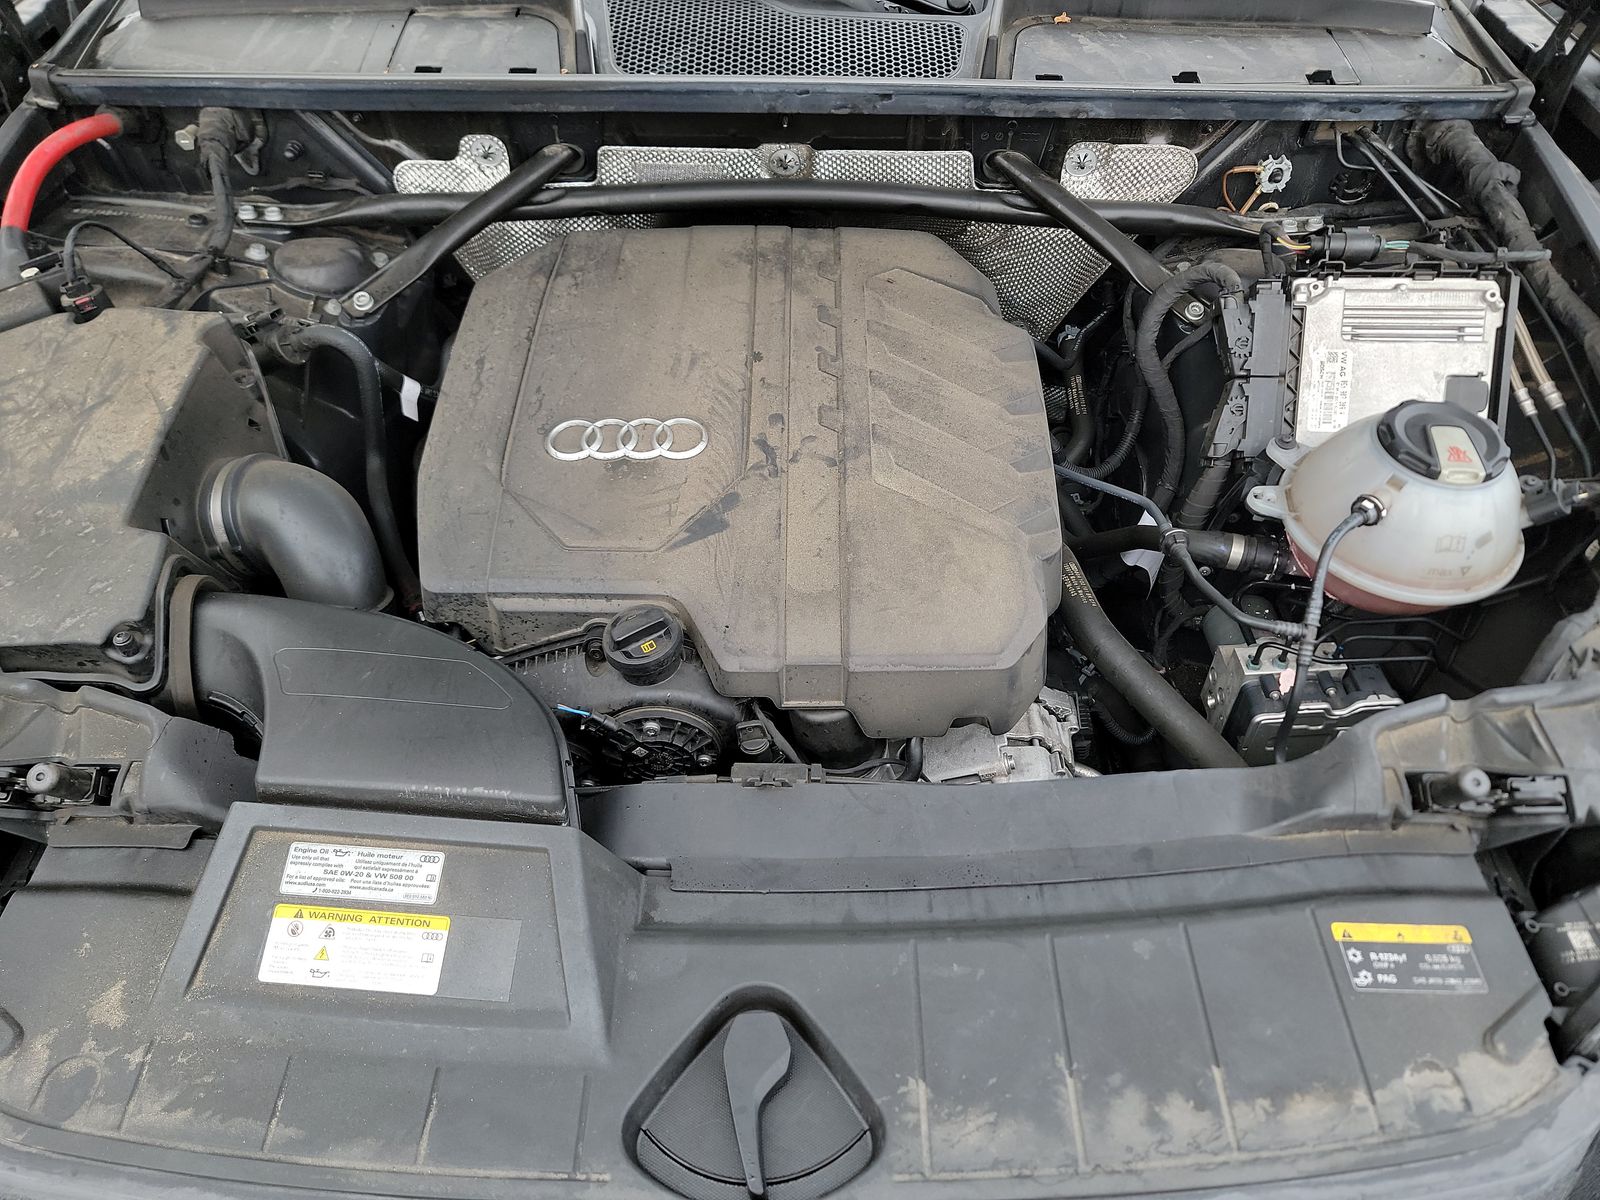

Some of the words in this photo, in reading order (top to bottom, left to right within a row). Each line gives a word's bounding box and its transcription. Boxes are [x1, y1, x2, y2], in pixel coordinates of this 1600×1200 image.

[1340, 351, 1348, 364] VW
[1340, 366, 1347, 378] AG
[293, 846, 318, 854] Engine
[308, 910, 362, 923] WARNING
[368, 915, 431, 928] ATTENTION
